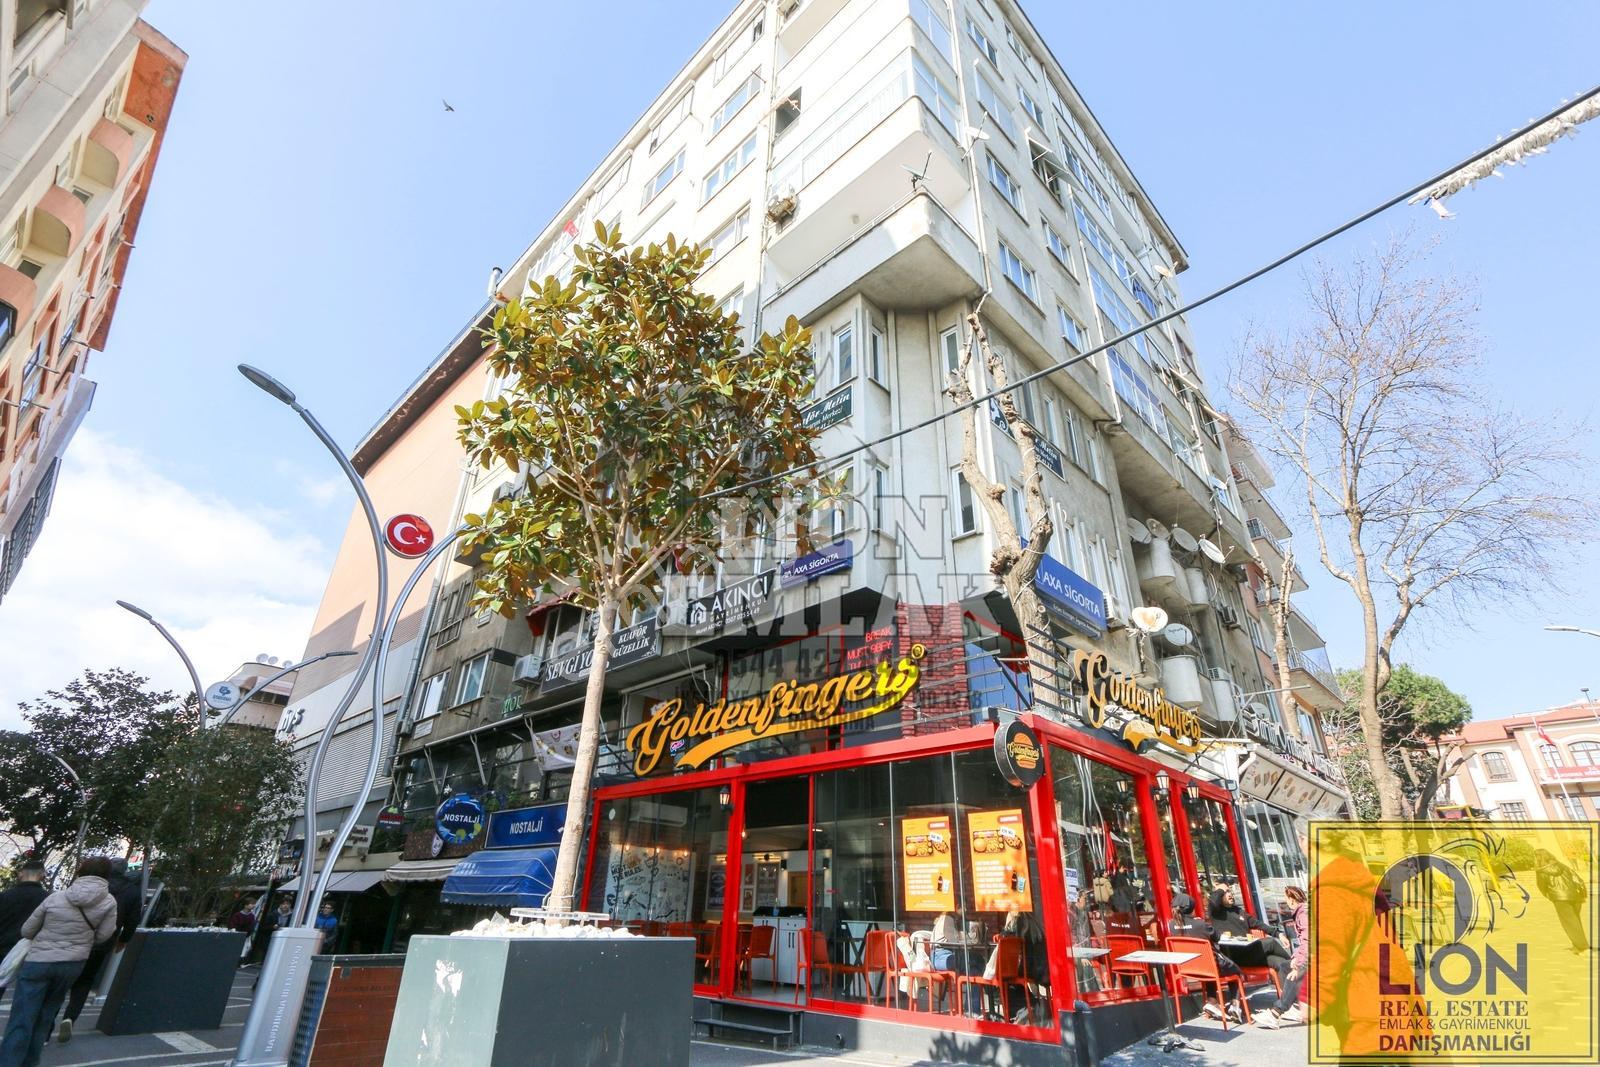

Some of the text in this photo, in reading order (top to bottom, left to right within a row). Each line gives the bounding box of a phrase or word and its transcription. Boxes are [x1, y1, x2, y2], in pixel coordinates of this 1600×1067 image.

[794, 564, 808, 575] AXA
[809, 552, 839, 570] SİGORTA
[712, 576, 768, 612] AKINCI
[1043, 571, 1101, 618] AXA SİGORTA
[617, 624, 648, 644] KUAFÖR
[612, 636, 650, 658] GÜZELLİK
[626, 657, 919, 776] Goldenfingers
[443, 813, 481, 824] NOSTALJİ
[509, 816, 544, 835] NOSTALJİ
